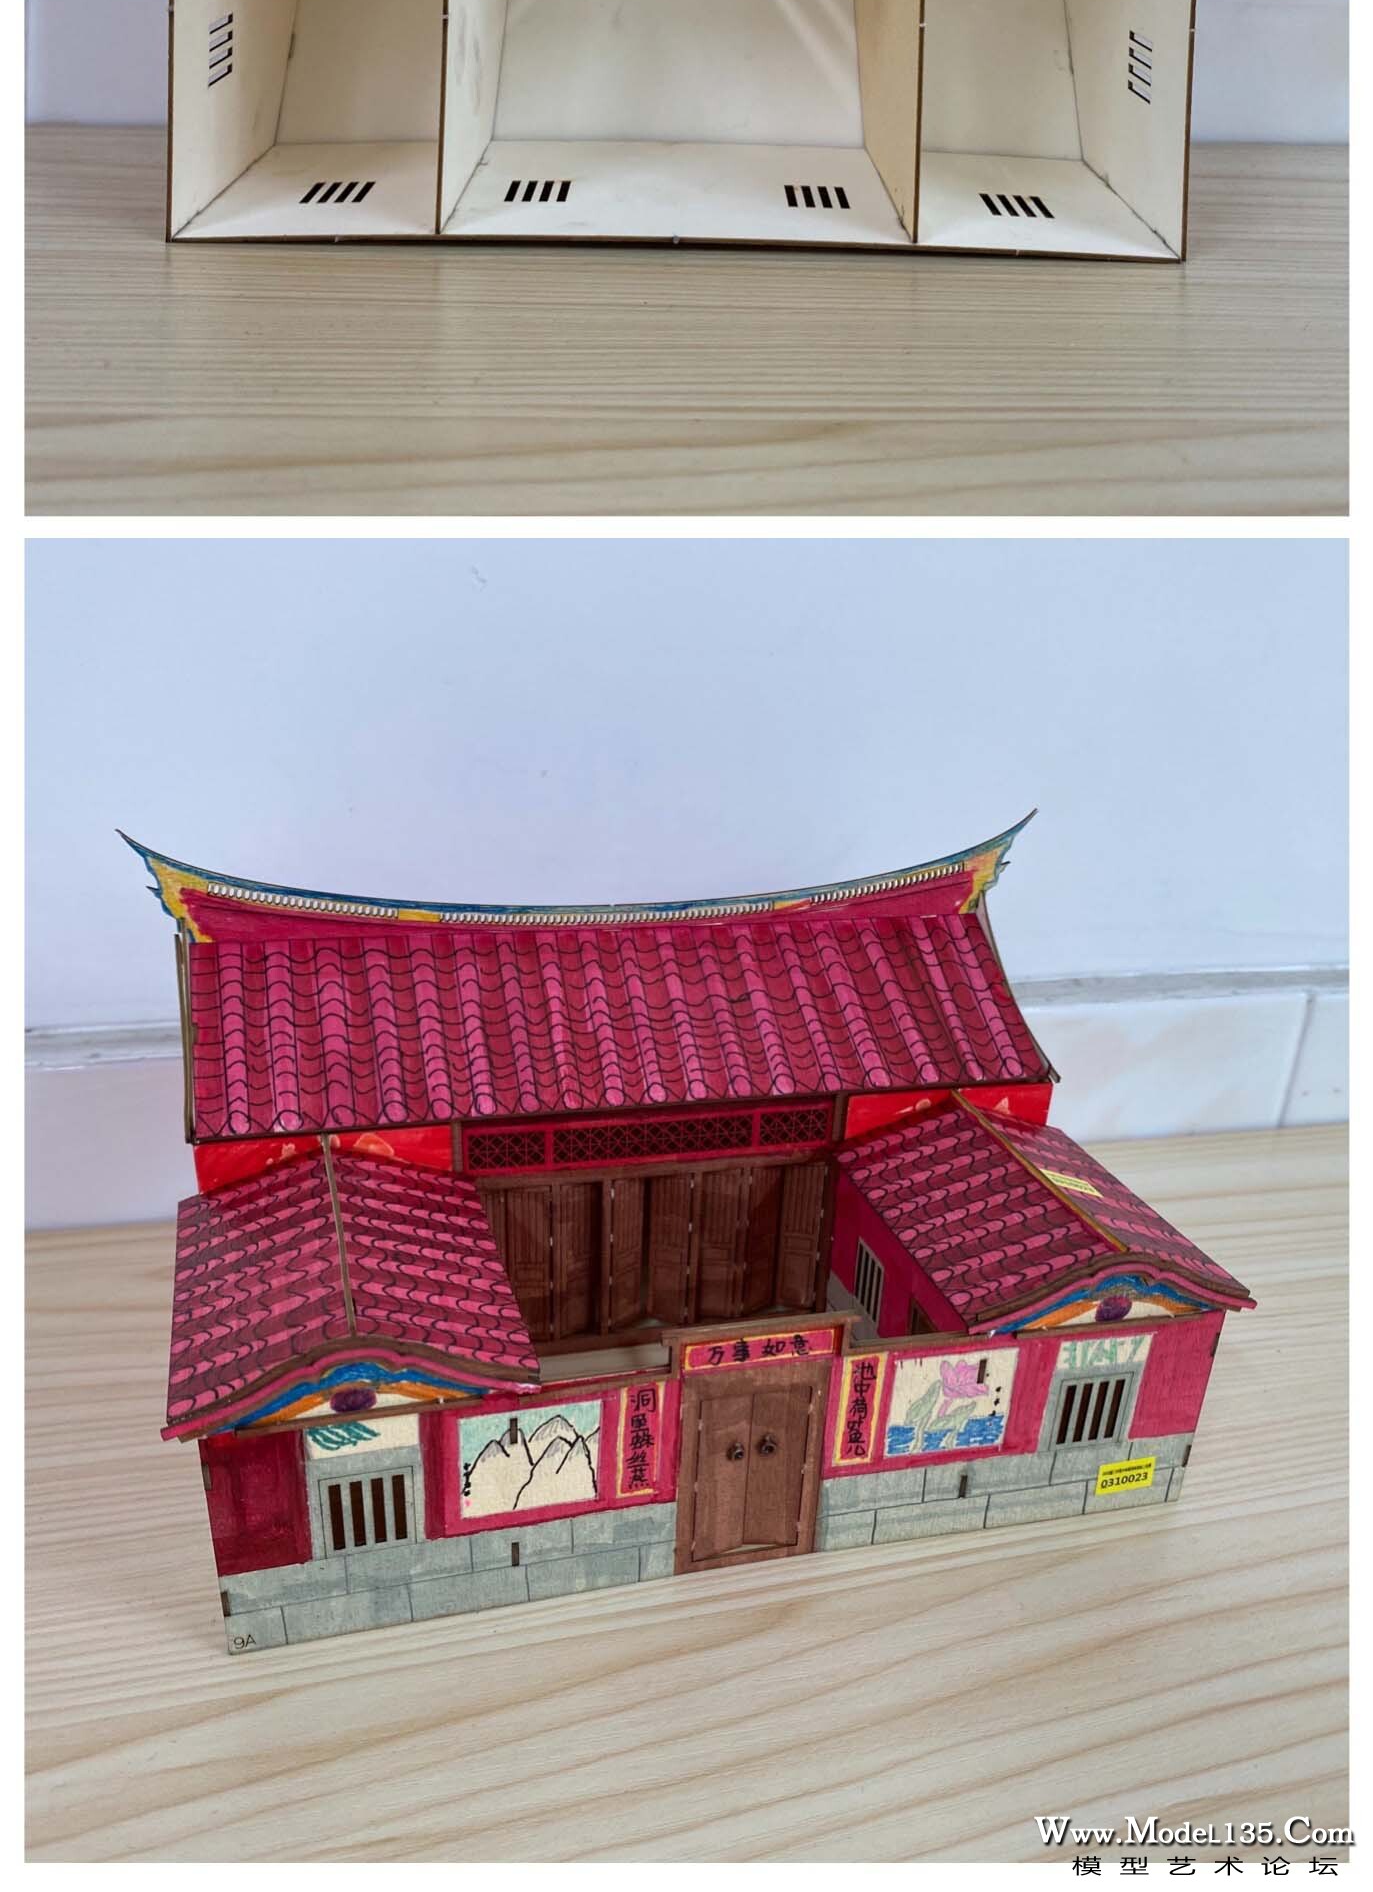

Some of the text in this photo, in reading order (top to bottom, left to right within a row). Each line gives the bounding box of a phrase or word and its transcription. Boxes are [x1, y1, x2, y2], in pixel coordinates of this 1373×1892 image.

[706, 1334, 812, 1366] 万事如意
[1101, 1471, 1149, 1490] 0310023
[233, 1634, 257, 1650] 9A
